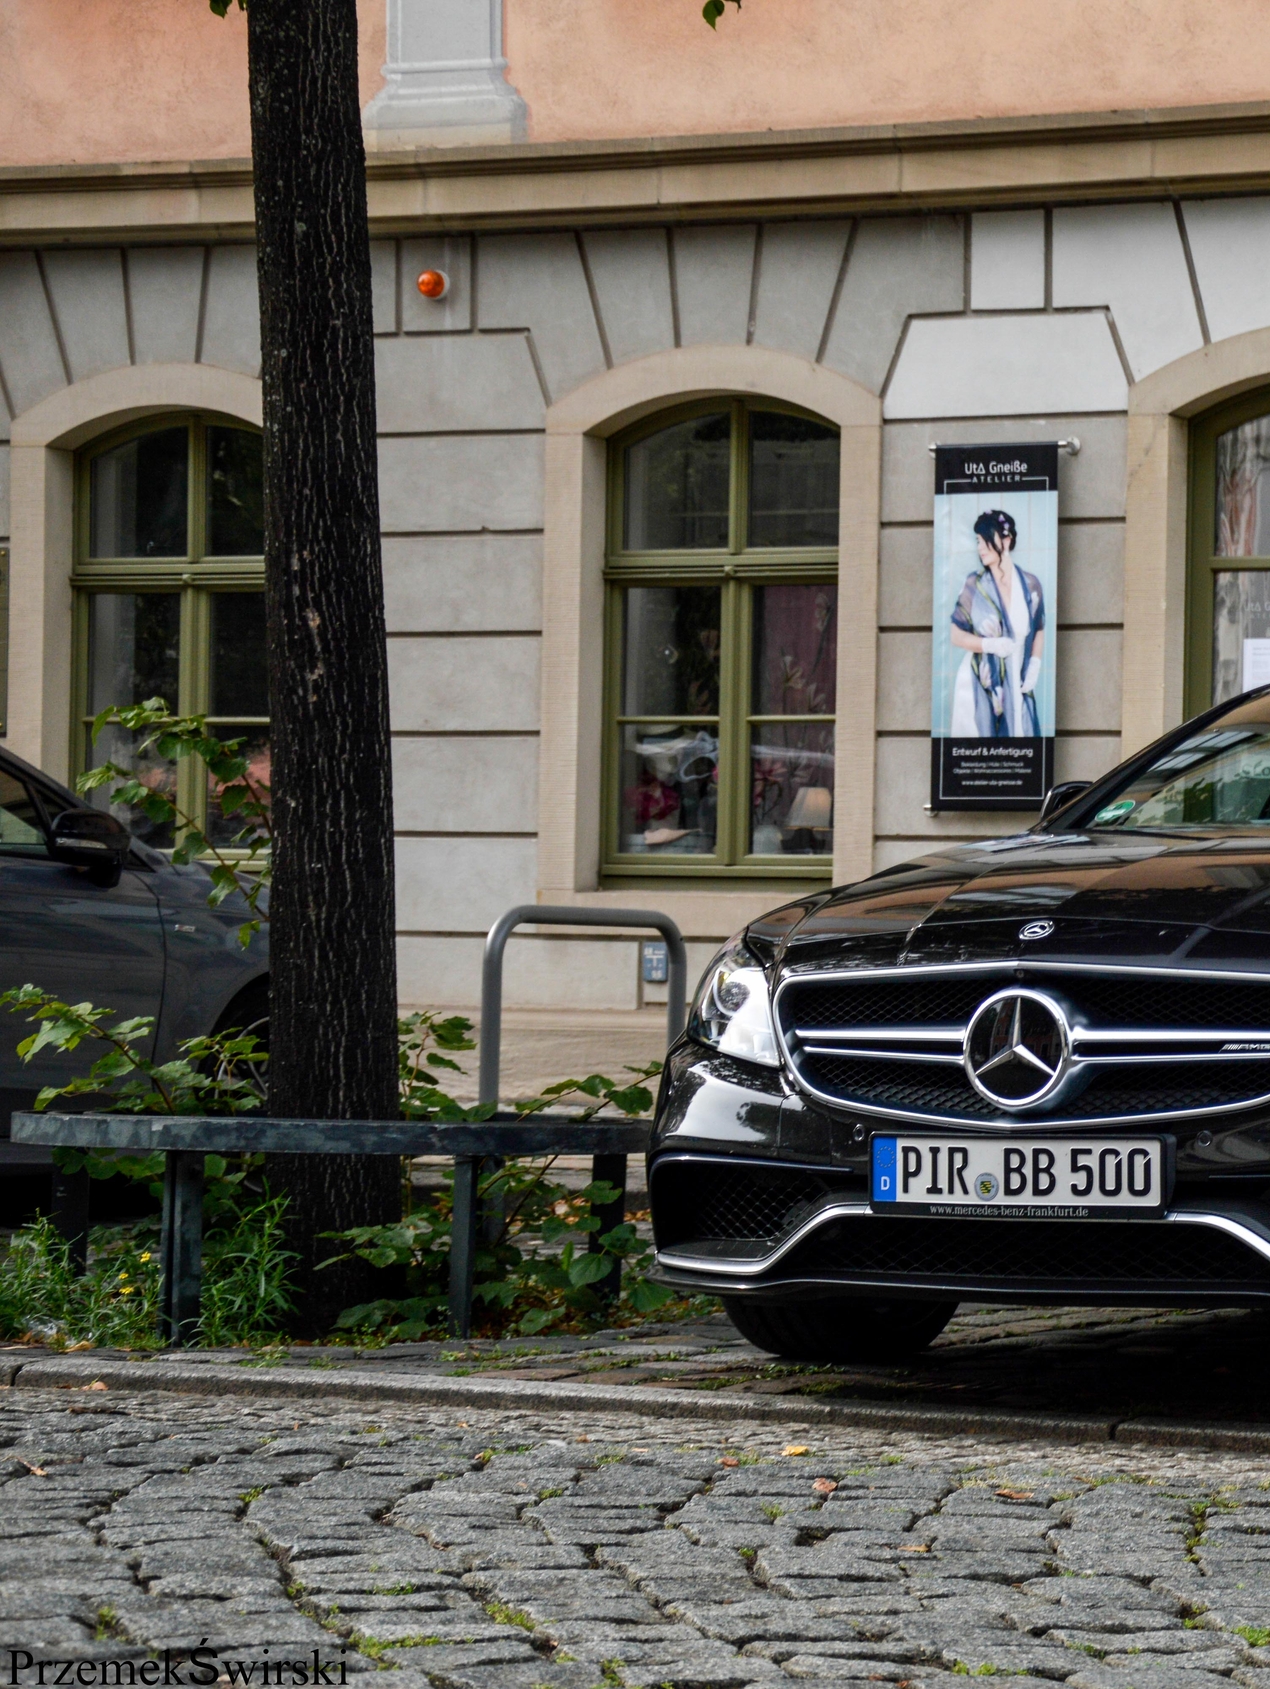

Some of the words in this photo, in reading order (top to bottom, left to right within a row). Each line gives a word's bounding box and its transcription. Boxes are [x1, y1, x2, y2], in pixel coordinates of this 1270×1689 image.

[989, 460, 1028, 474] Gneiße
[972, 475, 1020, 483] ATELIER
[952, 747, 981, 757] Entwurf
[982, 747, 988, 757] &
[989, 747, 1033, 758] Anfertigung
[880, 1176, 890, 1190] D
[901, 1146, 970, 1195] PIR
[1003, 1147, 1056, 1196] BB
[1070, 1148, 1151, 1196] 500
[930, 1205, 1089, 1217] www.mercedes-benz-frankfurt.de
